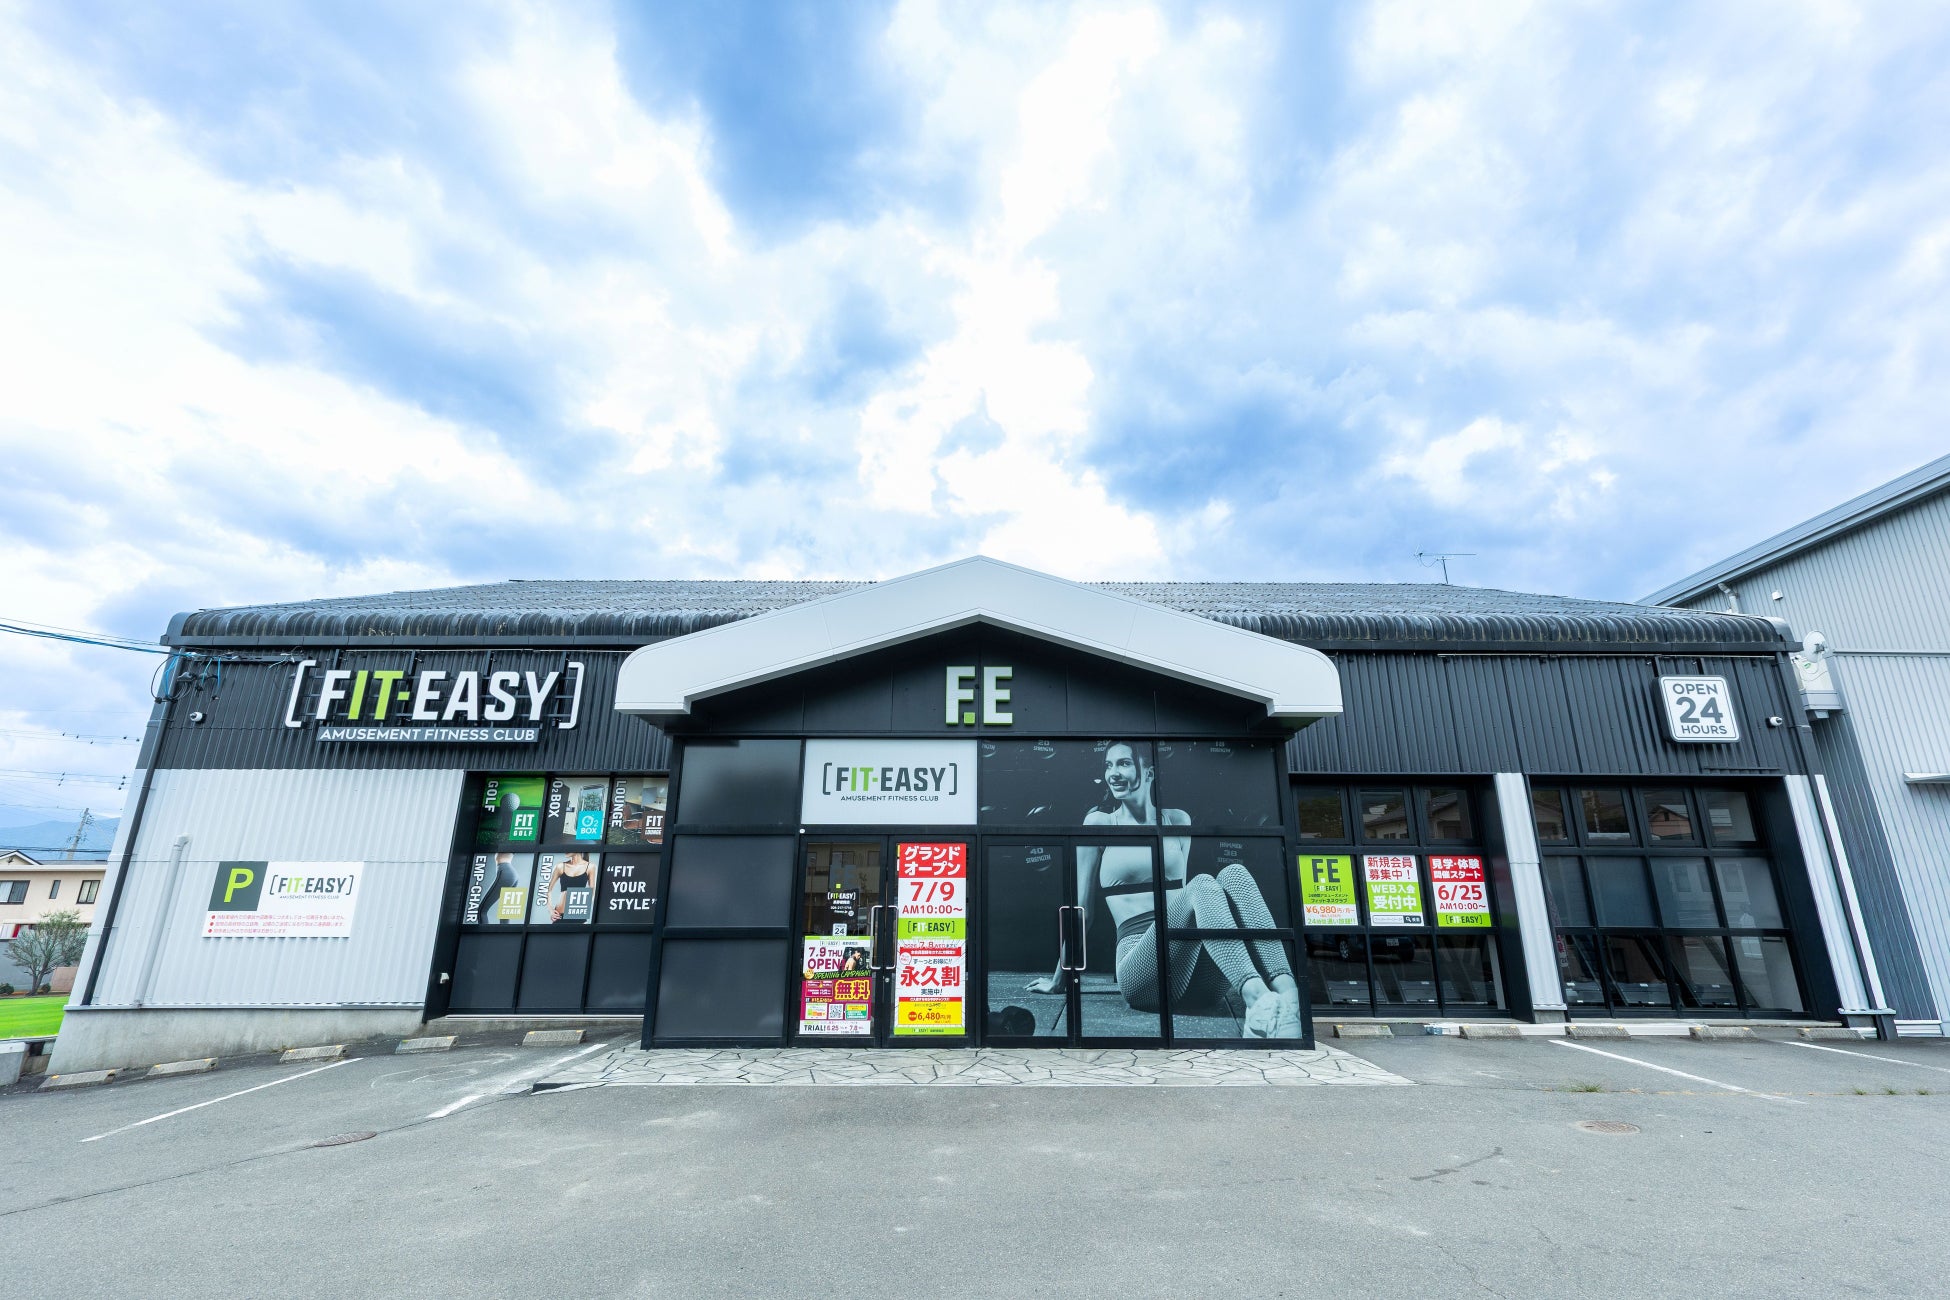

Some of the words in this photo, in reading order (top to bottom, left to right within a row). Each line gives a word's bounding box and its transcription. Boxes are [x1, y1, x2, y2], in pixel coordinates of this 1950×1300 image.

[1672, 683, 1719, 695] OPEN
[1676, 696, 1724, 724] 24
[320, 729, 423, 740] AMUSEMENT
[424, 729, 489, 741] FITNESS
[493, 729, 535, 741] CLUB
[1681, 725, 1728, 734] HOURS
[485, 780, 499, 813] GOLF
[611, 780, 627, 828] LOUNGE
[548, 793, 562, 818] BOX
[514, 813, 535, 827] FIT
[646, 815, 664, 827] FIT
[580, 827, 597, 835] BOX
[904, 845, 961, 861] グランド
[540, 855, 554, 881] EMP
[904, 861, 961, 876] オープン
[1367, 856, 1413, 868] 新規会員
[1434, 870, 1481, 879] 開催スタート
[223, 868, 254, 903] P
[466, 855, 487, 923] EMP-CHAIR
[612, 881, 647, 893] YOUR
[910, 881, 955, 902] 7/9
[1437, 884, 1483, 901] 6/25
[502, 891, 524, 905] FIT
[569, 891, 590, 905] FIT
[1373, 895, 1417, 910] 受付中
[834, 927, 845, 935] 24
[808, 946, 826, 957] 7.9
[900, 965, 960, 987] 永久割
[835, 980, 870, 1000] 無料
